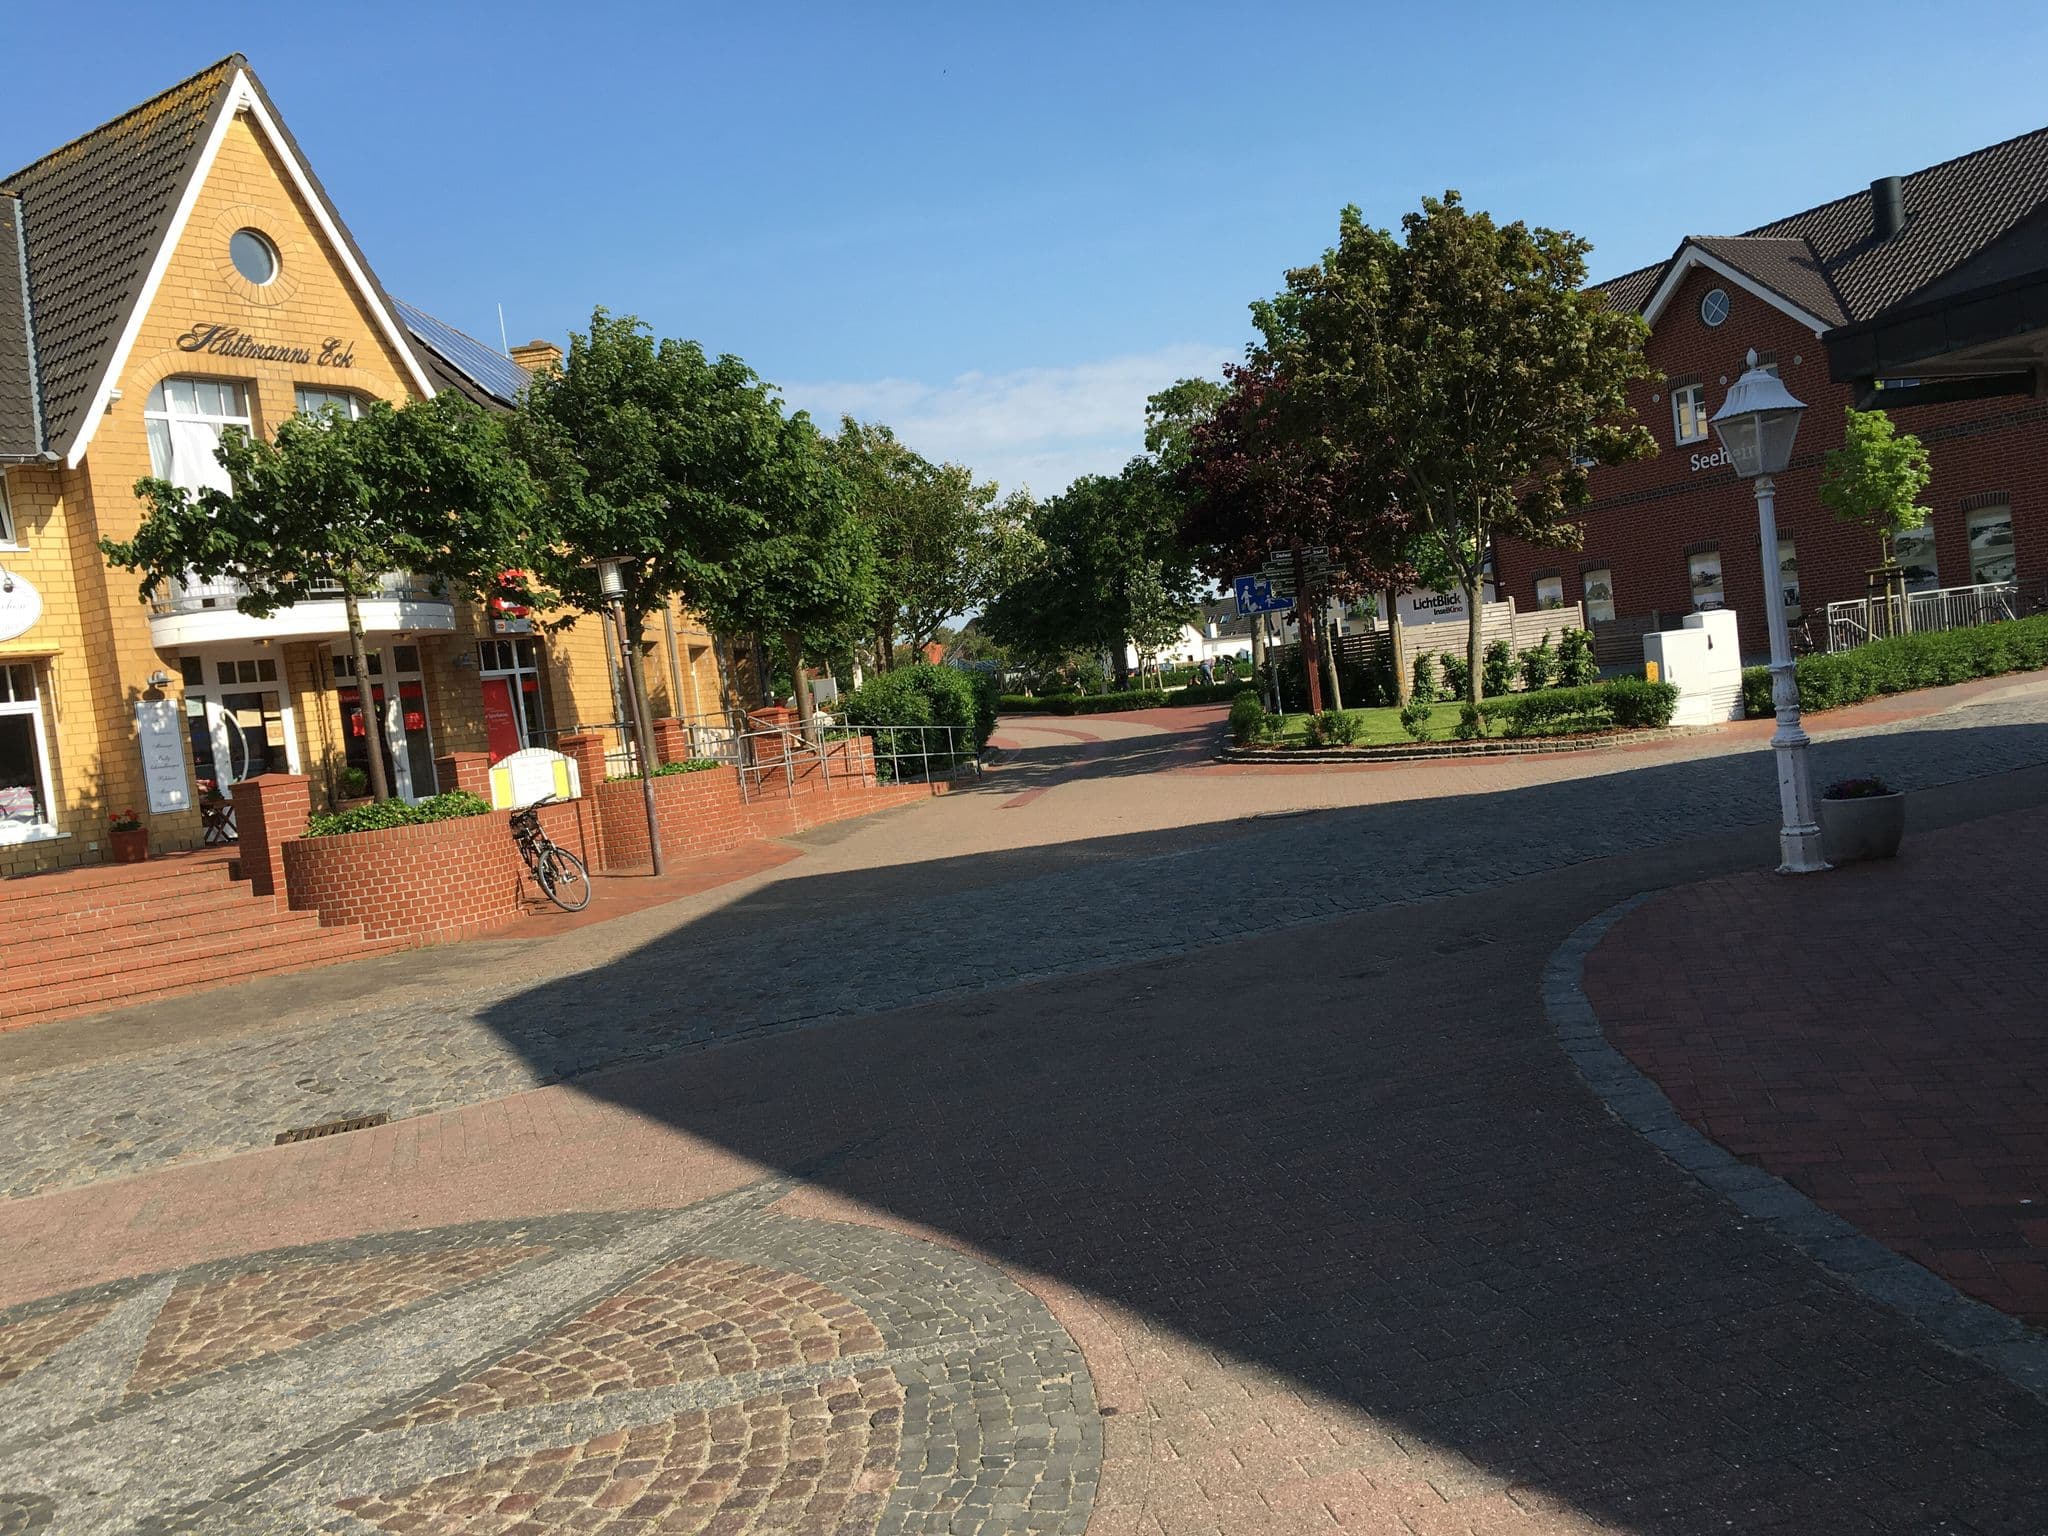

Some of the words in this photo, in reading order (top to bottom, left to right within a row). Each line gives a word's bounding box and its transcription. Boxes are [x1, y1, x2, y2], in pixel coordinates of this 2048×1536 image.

[317, 337, 354, 368] Eck
[1413, 593, 1461, 610] LichtBlick
[1433, 606, 1463, 615] InselKino
